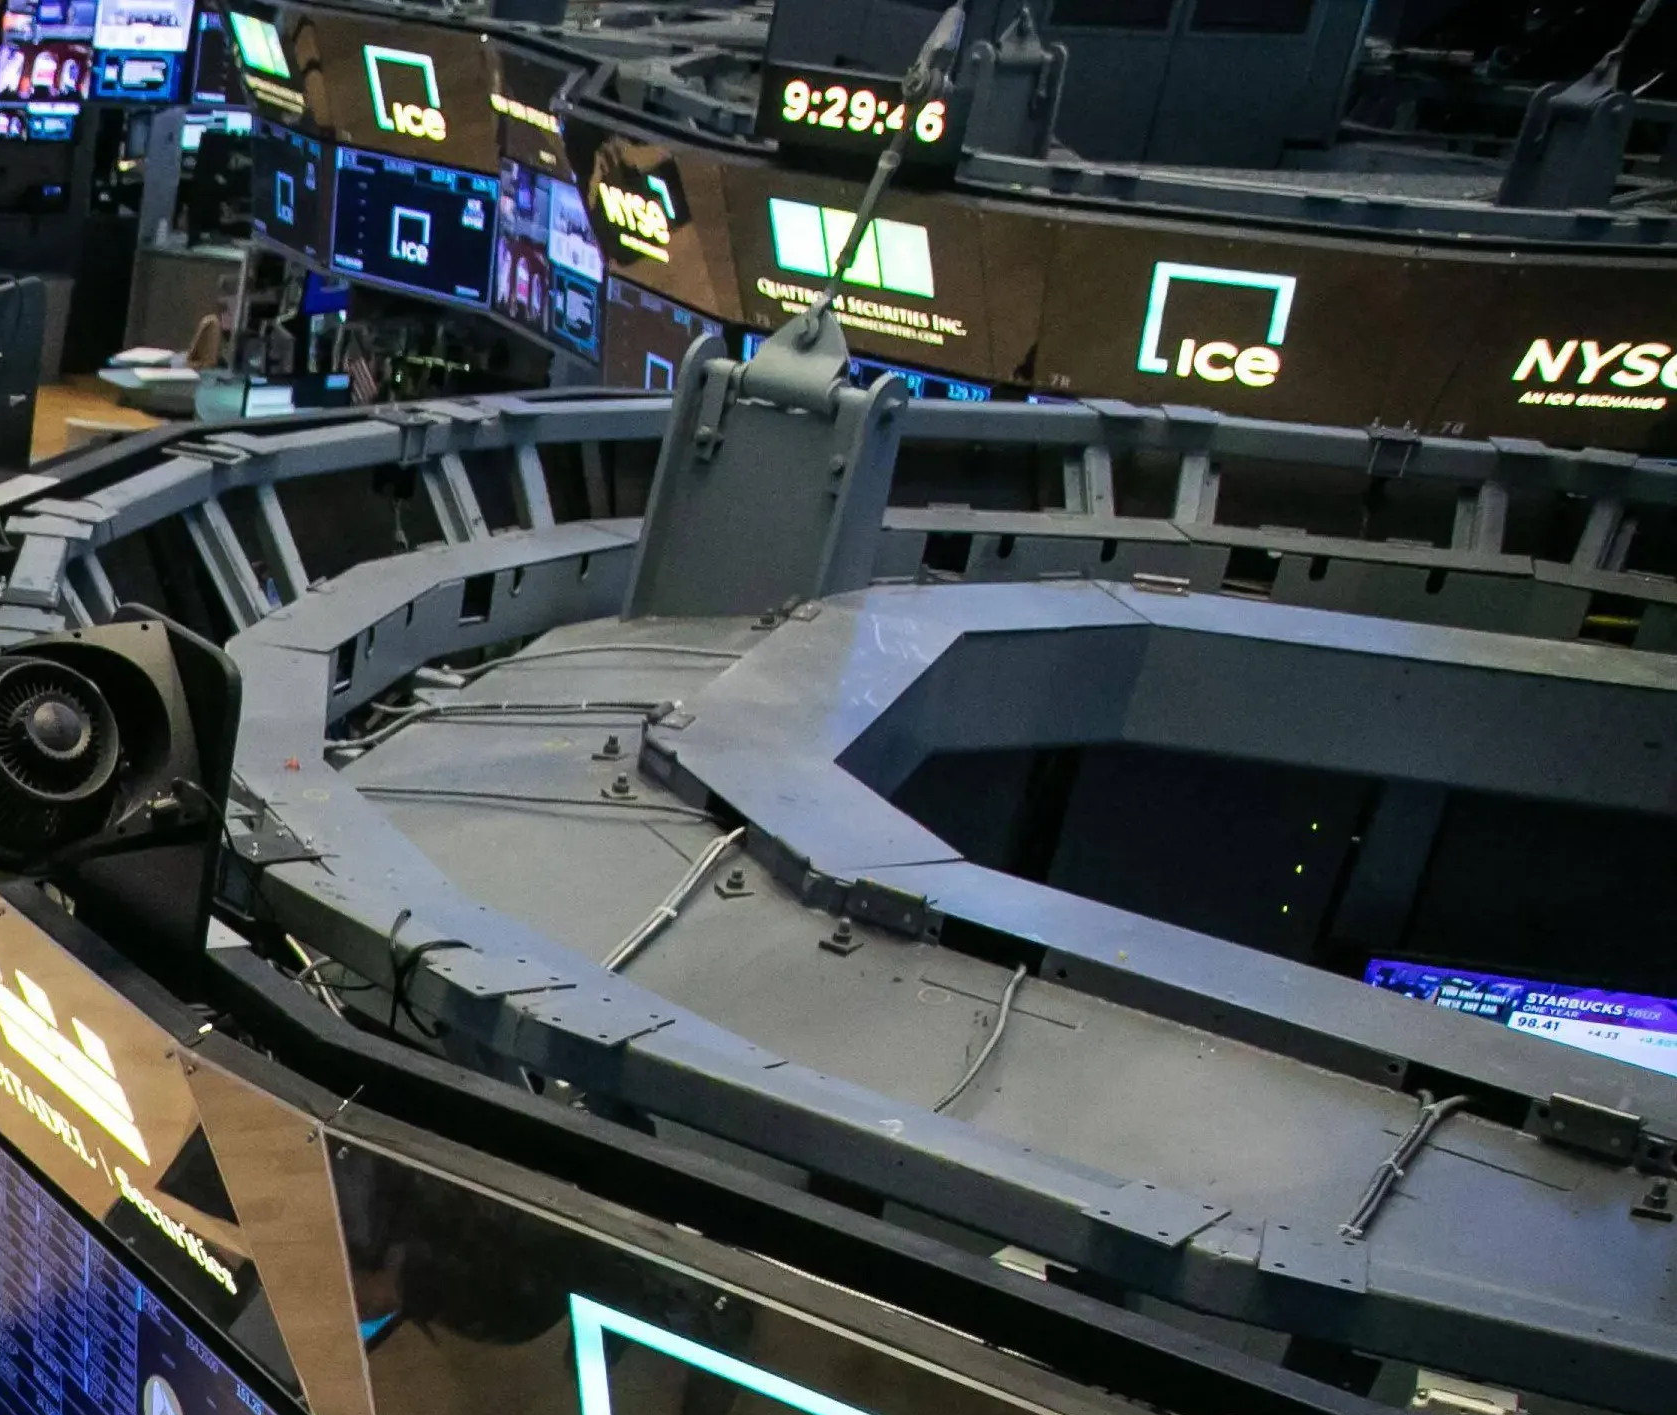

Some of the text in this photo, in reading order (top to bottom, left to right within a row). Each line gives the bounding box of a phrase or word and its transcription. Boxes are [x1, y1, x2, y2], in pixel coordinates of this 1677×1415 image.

[1522, 1003, 1580, 1019] ONE YEAR
[1526, 992, 1624, 1016] STARBUCKS
[1516, 1015, 1559, 1031] 98.41
[113, 1165, 239, 1297] Securities
